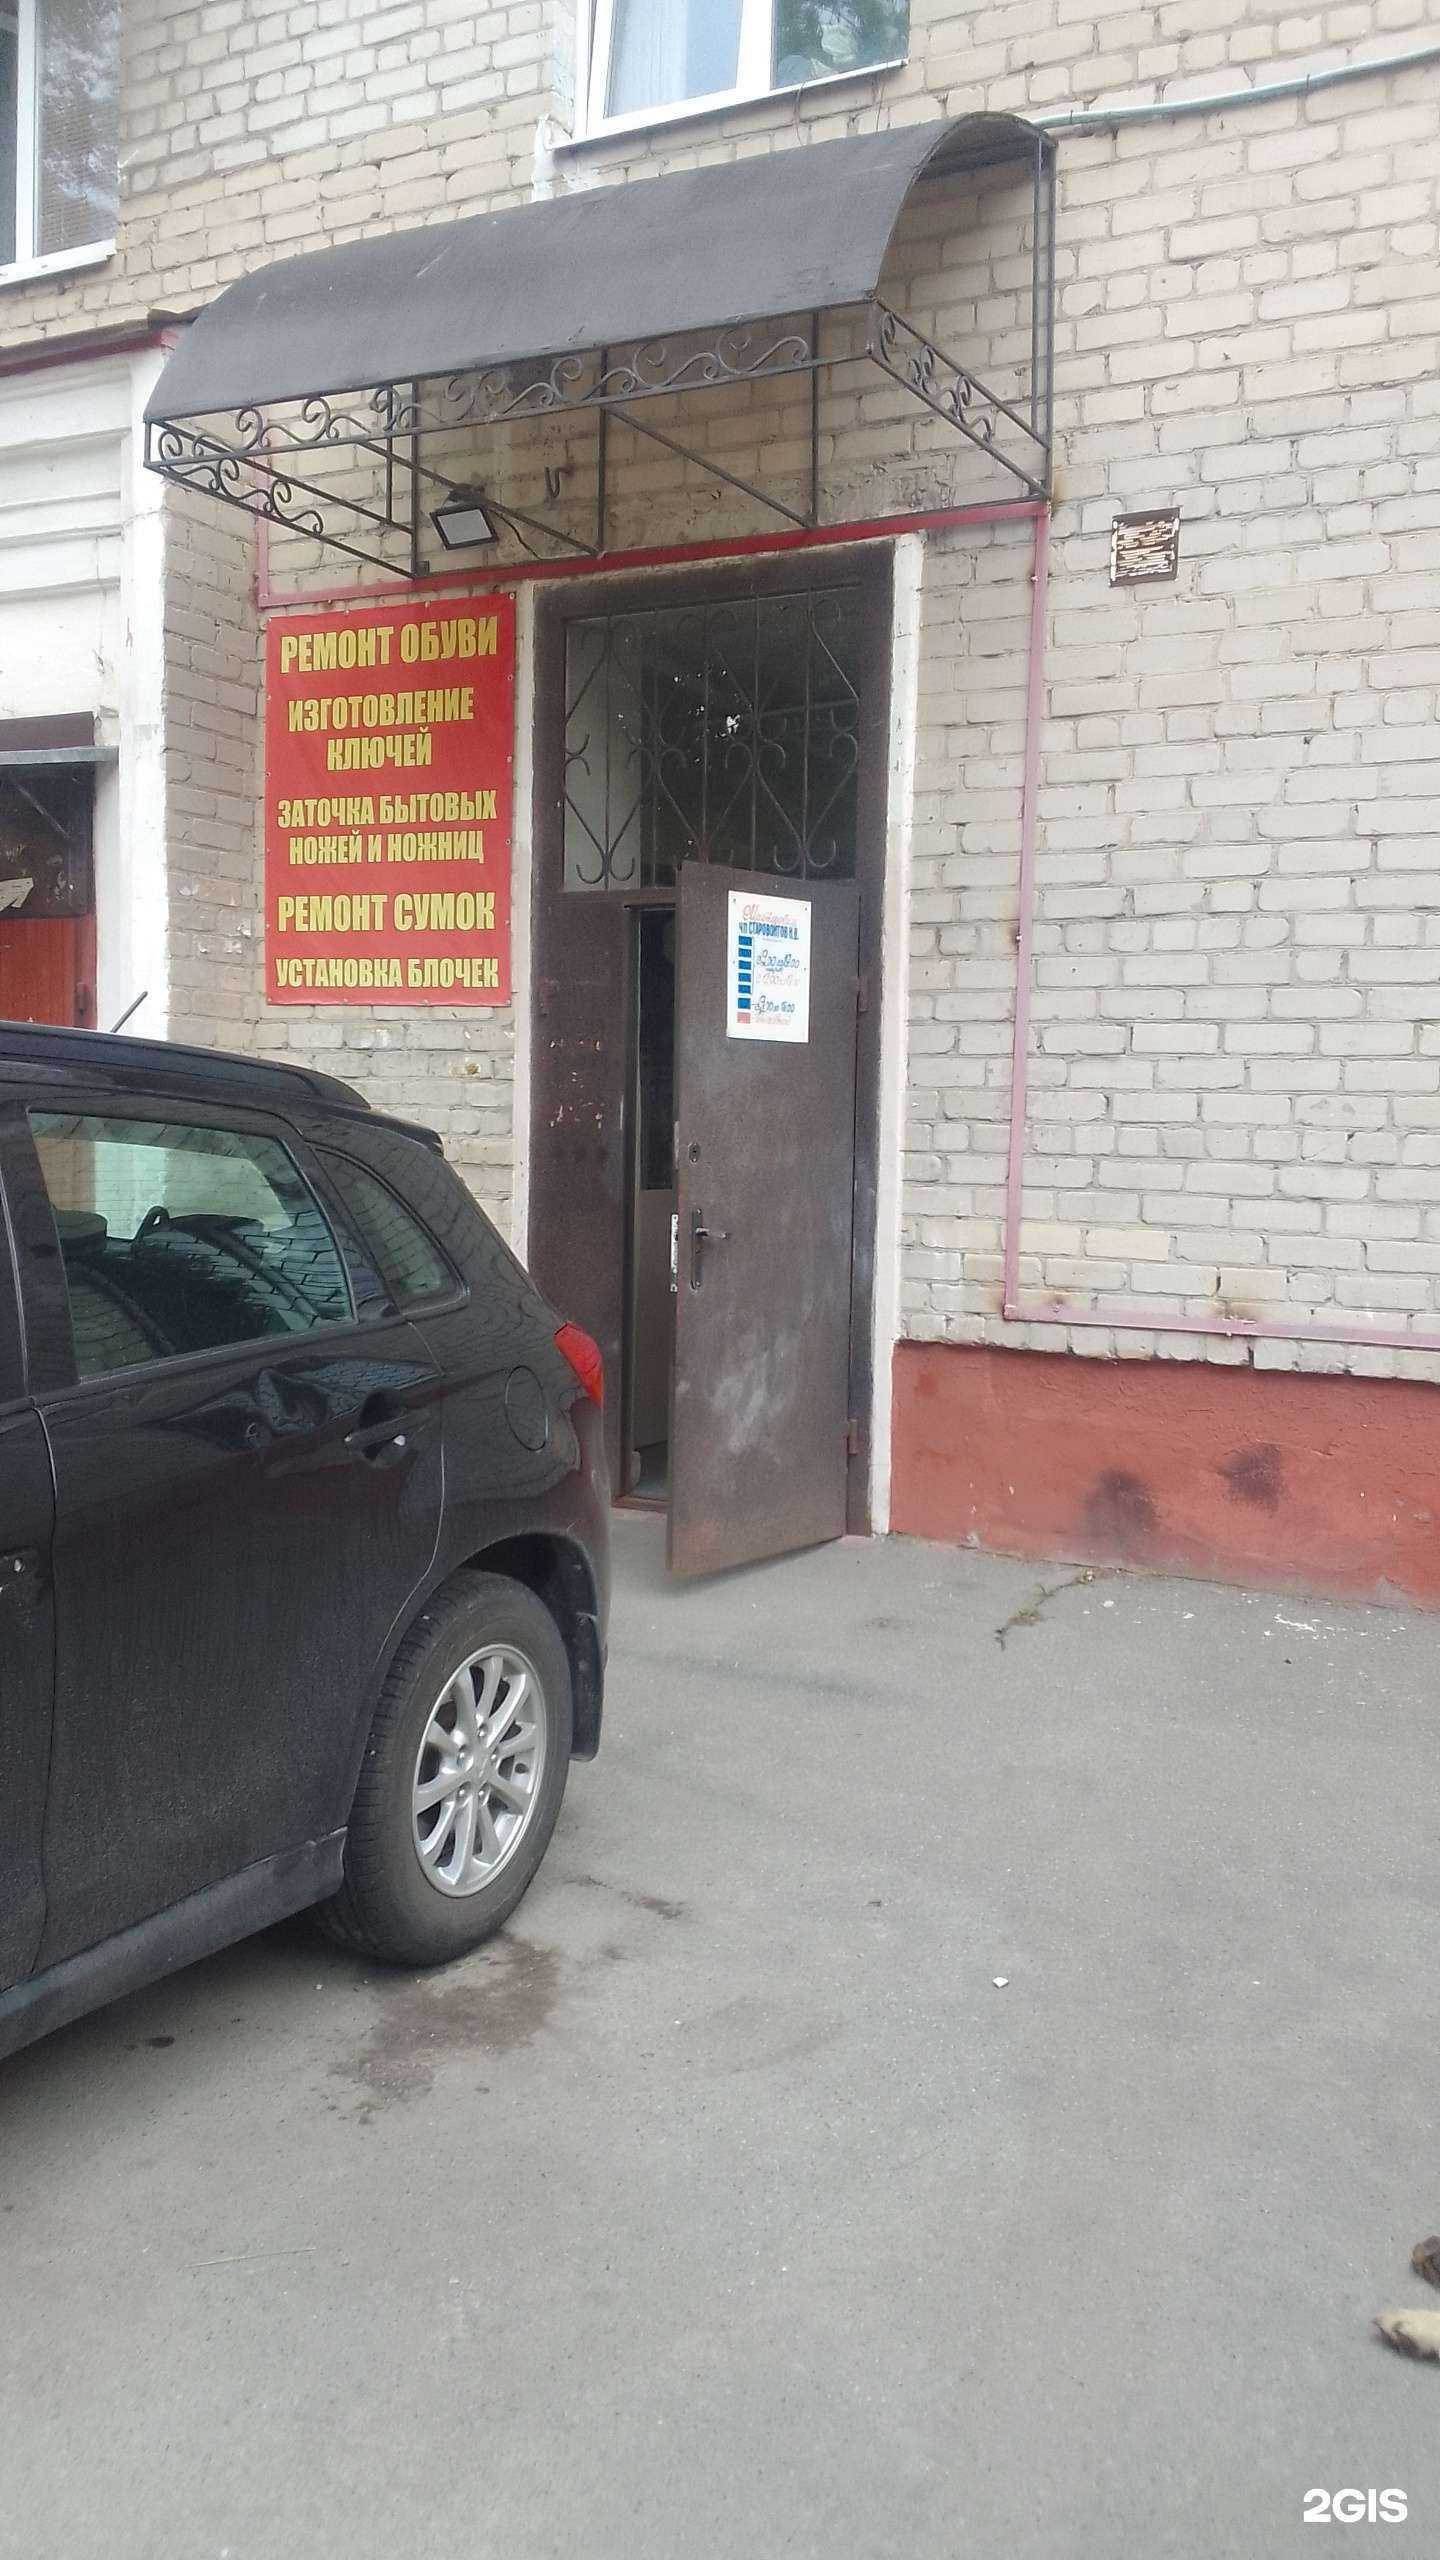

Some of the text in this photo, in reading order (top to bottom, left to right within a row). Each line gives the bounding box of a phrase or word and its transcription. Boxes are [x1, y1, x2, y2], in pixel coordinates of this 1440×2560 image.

[280, 615, 498, 674] РЕМОНТ ОБУВИ
[288, 687, 474, 732] ИЗГОТОВЛЕНИЕ
[327, 726, 432, 771] КЛЮЧЕЙ
[278, 790, 497, 828] ЗАТОЧКА БЫТОВЫХ
[289, 830, 484, 865] НОЖЕЙ И НОЖНИЦ
[278, 892, 496, 932] РЕМОНТ СУМОК
[276, 958, 499, 988] УСТАНОВКА БЛОЧЕК
